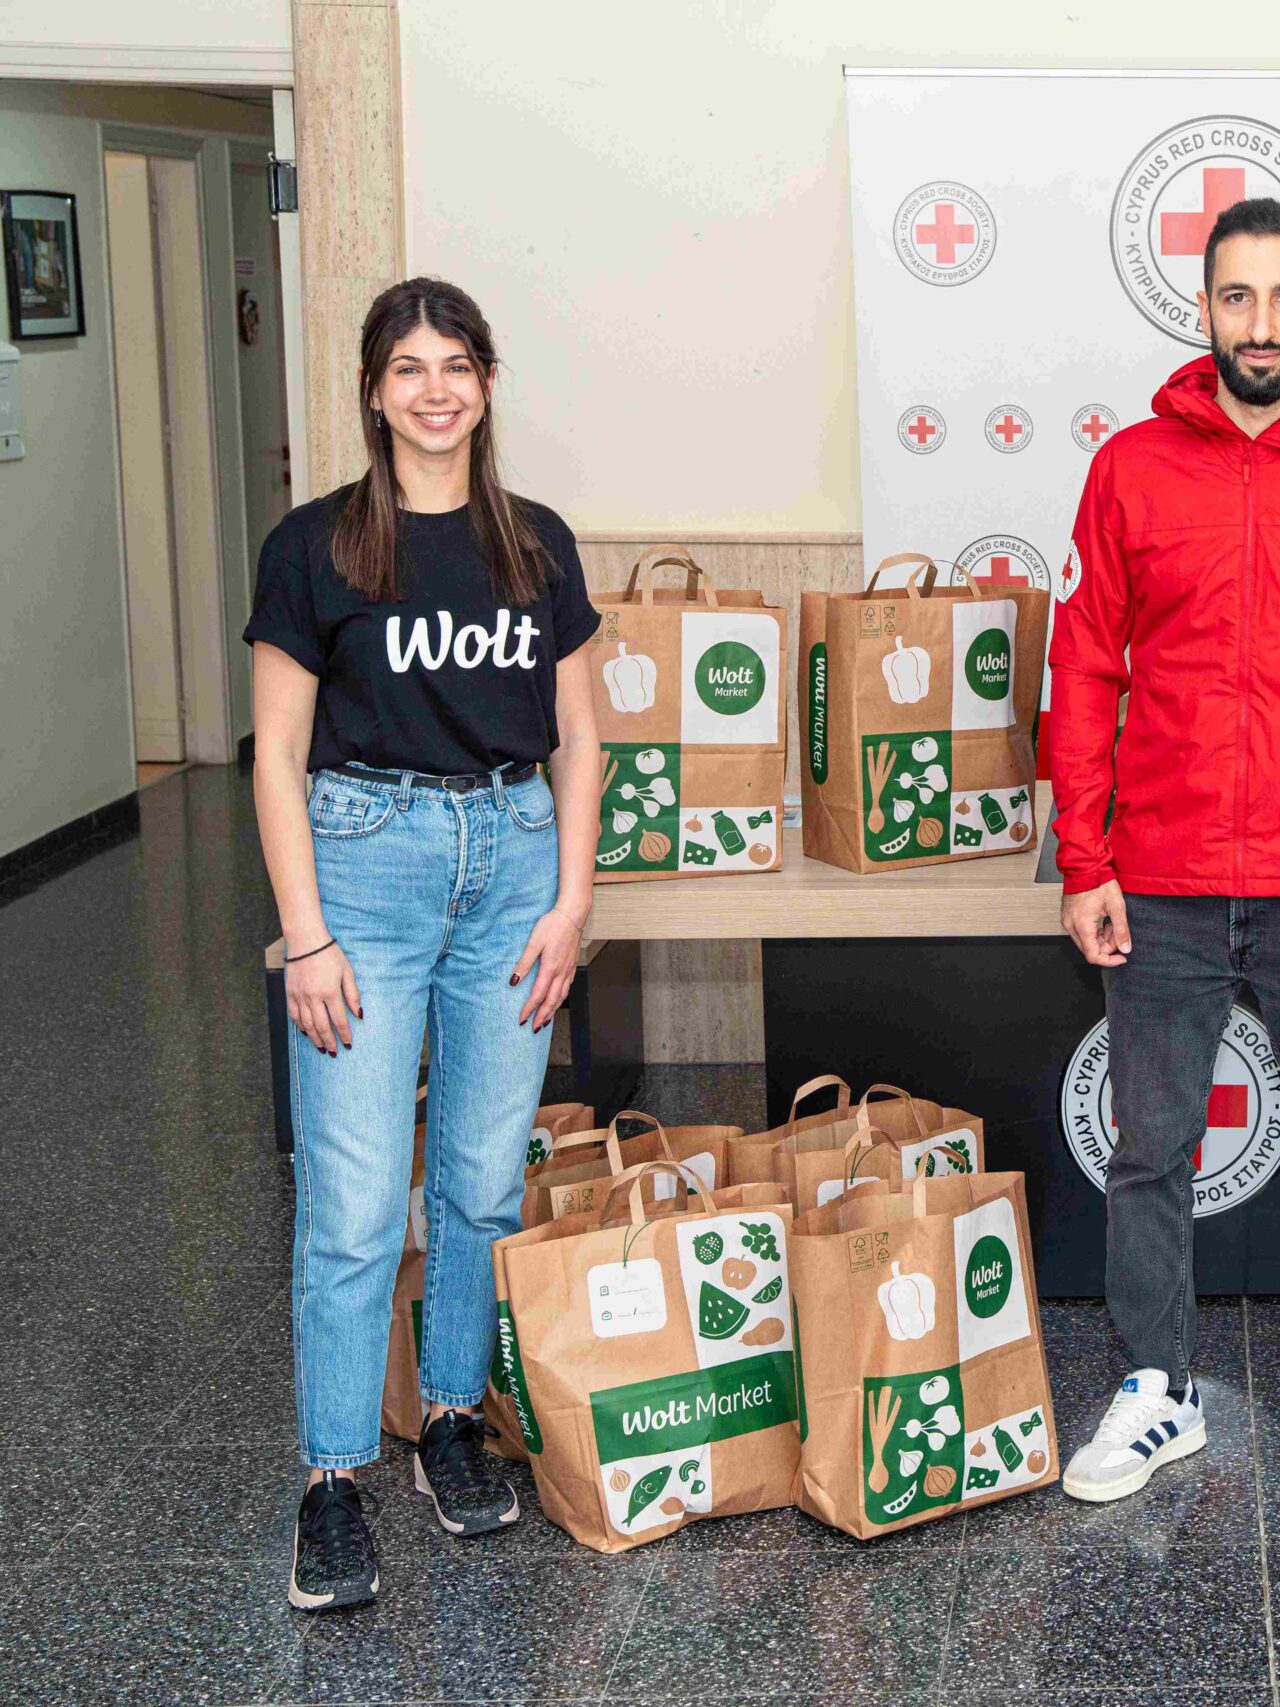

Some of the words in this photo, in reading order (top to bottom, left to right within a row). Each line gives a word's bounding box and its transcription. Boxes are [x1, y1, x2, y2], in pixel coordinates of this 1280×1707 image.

[1125, 154, 1169, 224] CYPRUS
[1168, 133, 1205, 160] RED
[1211, 129, 1273, 156] CROSS
[899, 199, 920, 230] CYPRUS
[919, 189, 936, 202] RED
[938, 187, 967, 200] CROSS
[966, 196, 991, 229] SOCIETY
[1125, 242, 1192, 328] ΚΥΠΡΙΑΚΟΣ
[975, 541, 992, 555] RED
[993, 540, 1021, 553] CROSS
[1021, 548, 1045, 580] SOCIETY
[386, 608, 540, 673] Wolt
[708, 666, 754, 684] Wolt
[976, 652, 1009, 672] Wolt
[981, 673, 1007, 684] Market
[714, 687, 748, 697] Market
[1074, 1029, 1110, 1096] CYPRU
[1074, 1114, 1108, 1177] ΚΥΠΡΙΑ
[972, 1261, 1003, 1289] Wolt
[976, 1283, 1000, 1301] Market
[622, 1400, 693, 1437] Wolt
[694, 1380, 773, 1423] Market
